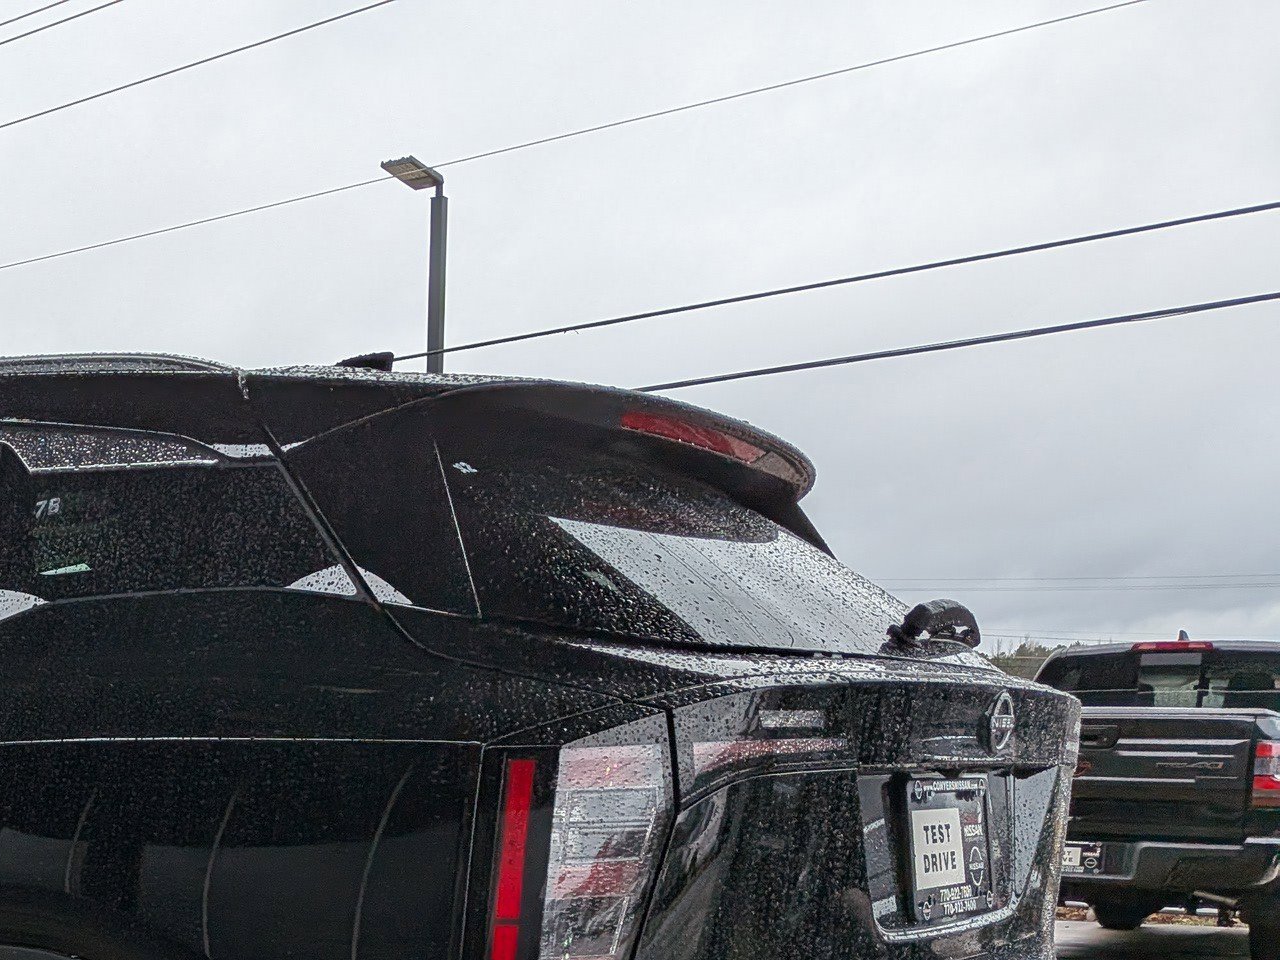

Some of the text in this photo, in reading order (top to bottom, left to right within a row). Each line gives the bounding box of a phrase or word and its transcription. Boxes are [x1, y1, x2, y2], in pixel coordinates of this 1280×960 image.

[923, 823, 951, 845] TEST
[964, 824, 983, 837] NISSAN
[923, 850, 957, 874] DRIVE
